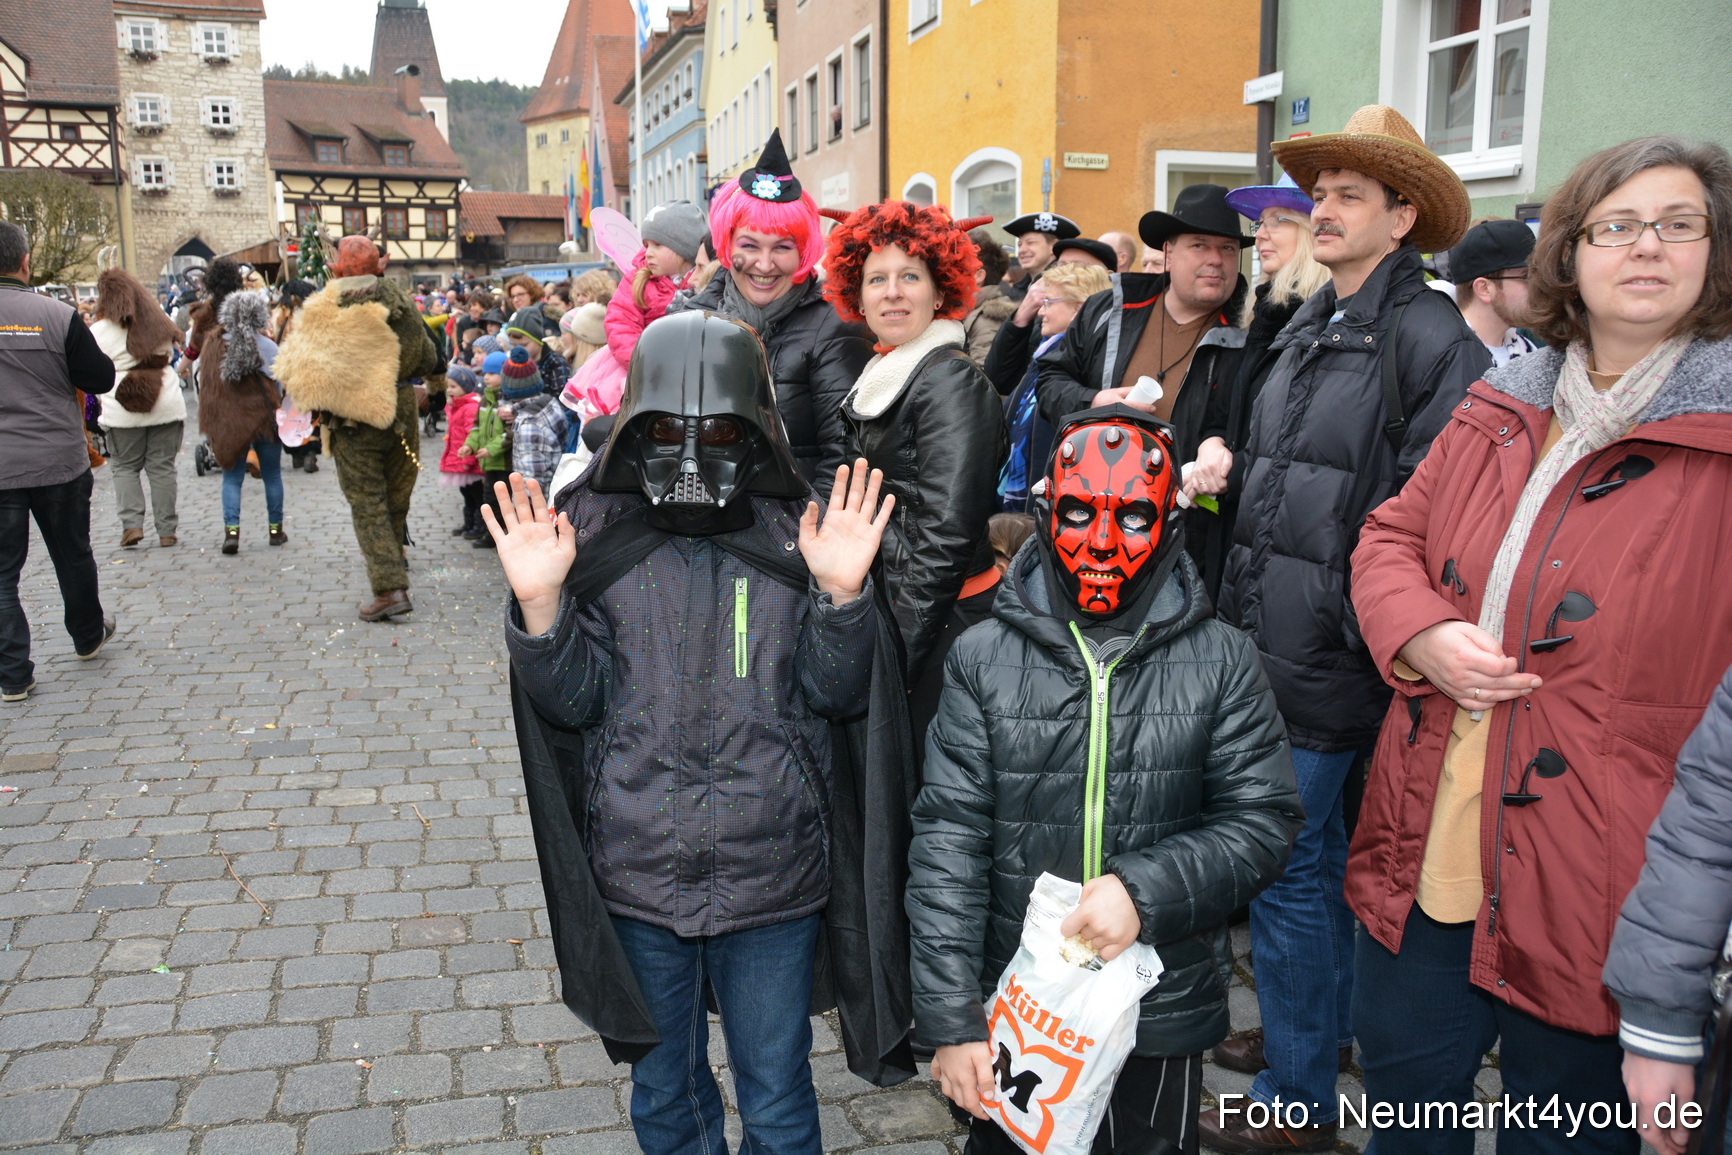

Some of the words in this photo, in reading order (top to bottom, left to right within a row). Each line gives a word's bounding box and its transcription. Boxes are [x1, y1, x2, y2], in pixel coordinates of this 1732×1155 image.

[1295, 100, 1306, 114] 17
[1067, 154, 1105, 166] Kirchgasse
[1005, 973, 1095, 1054] Müller
[992, 1041, 1043, 1114] M
